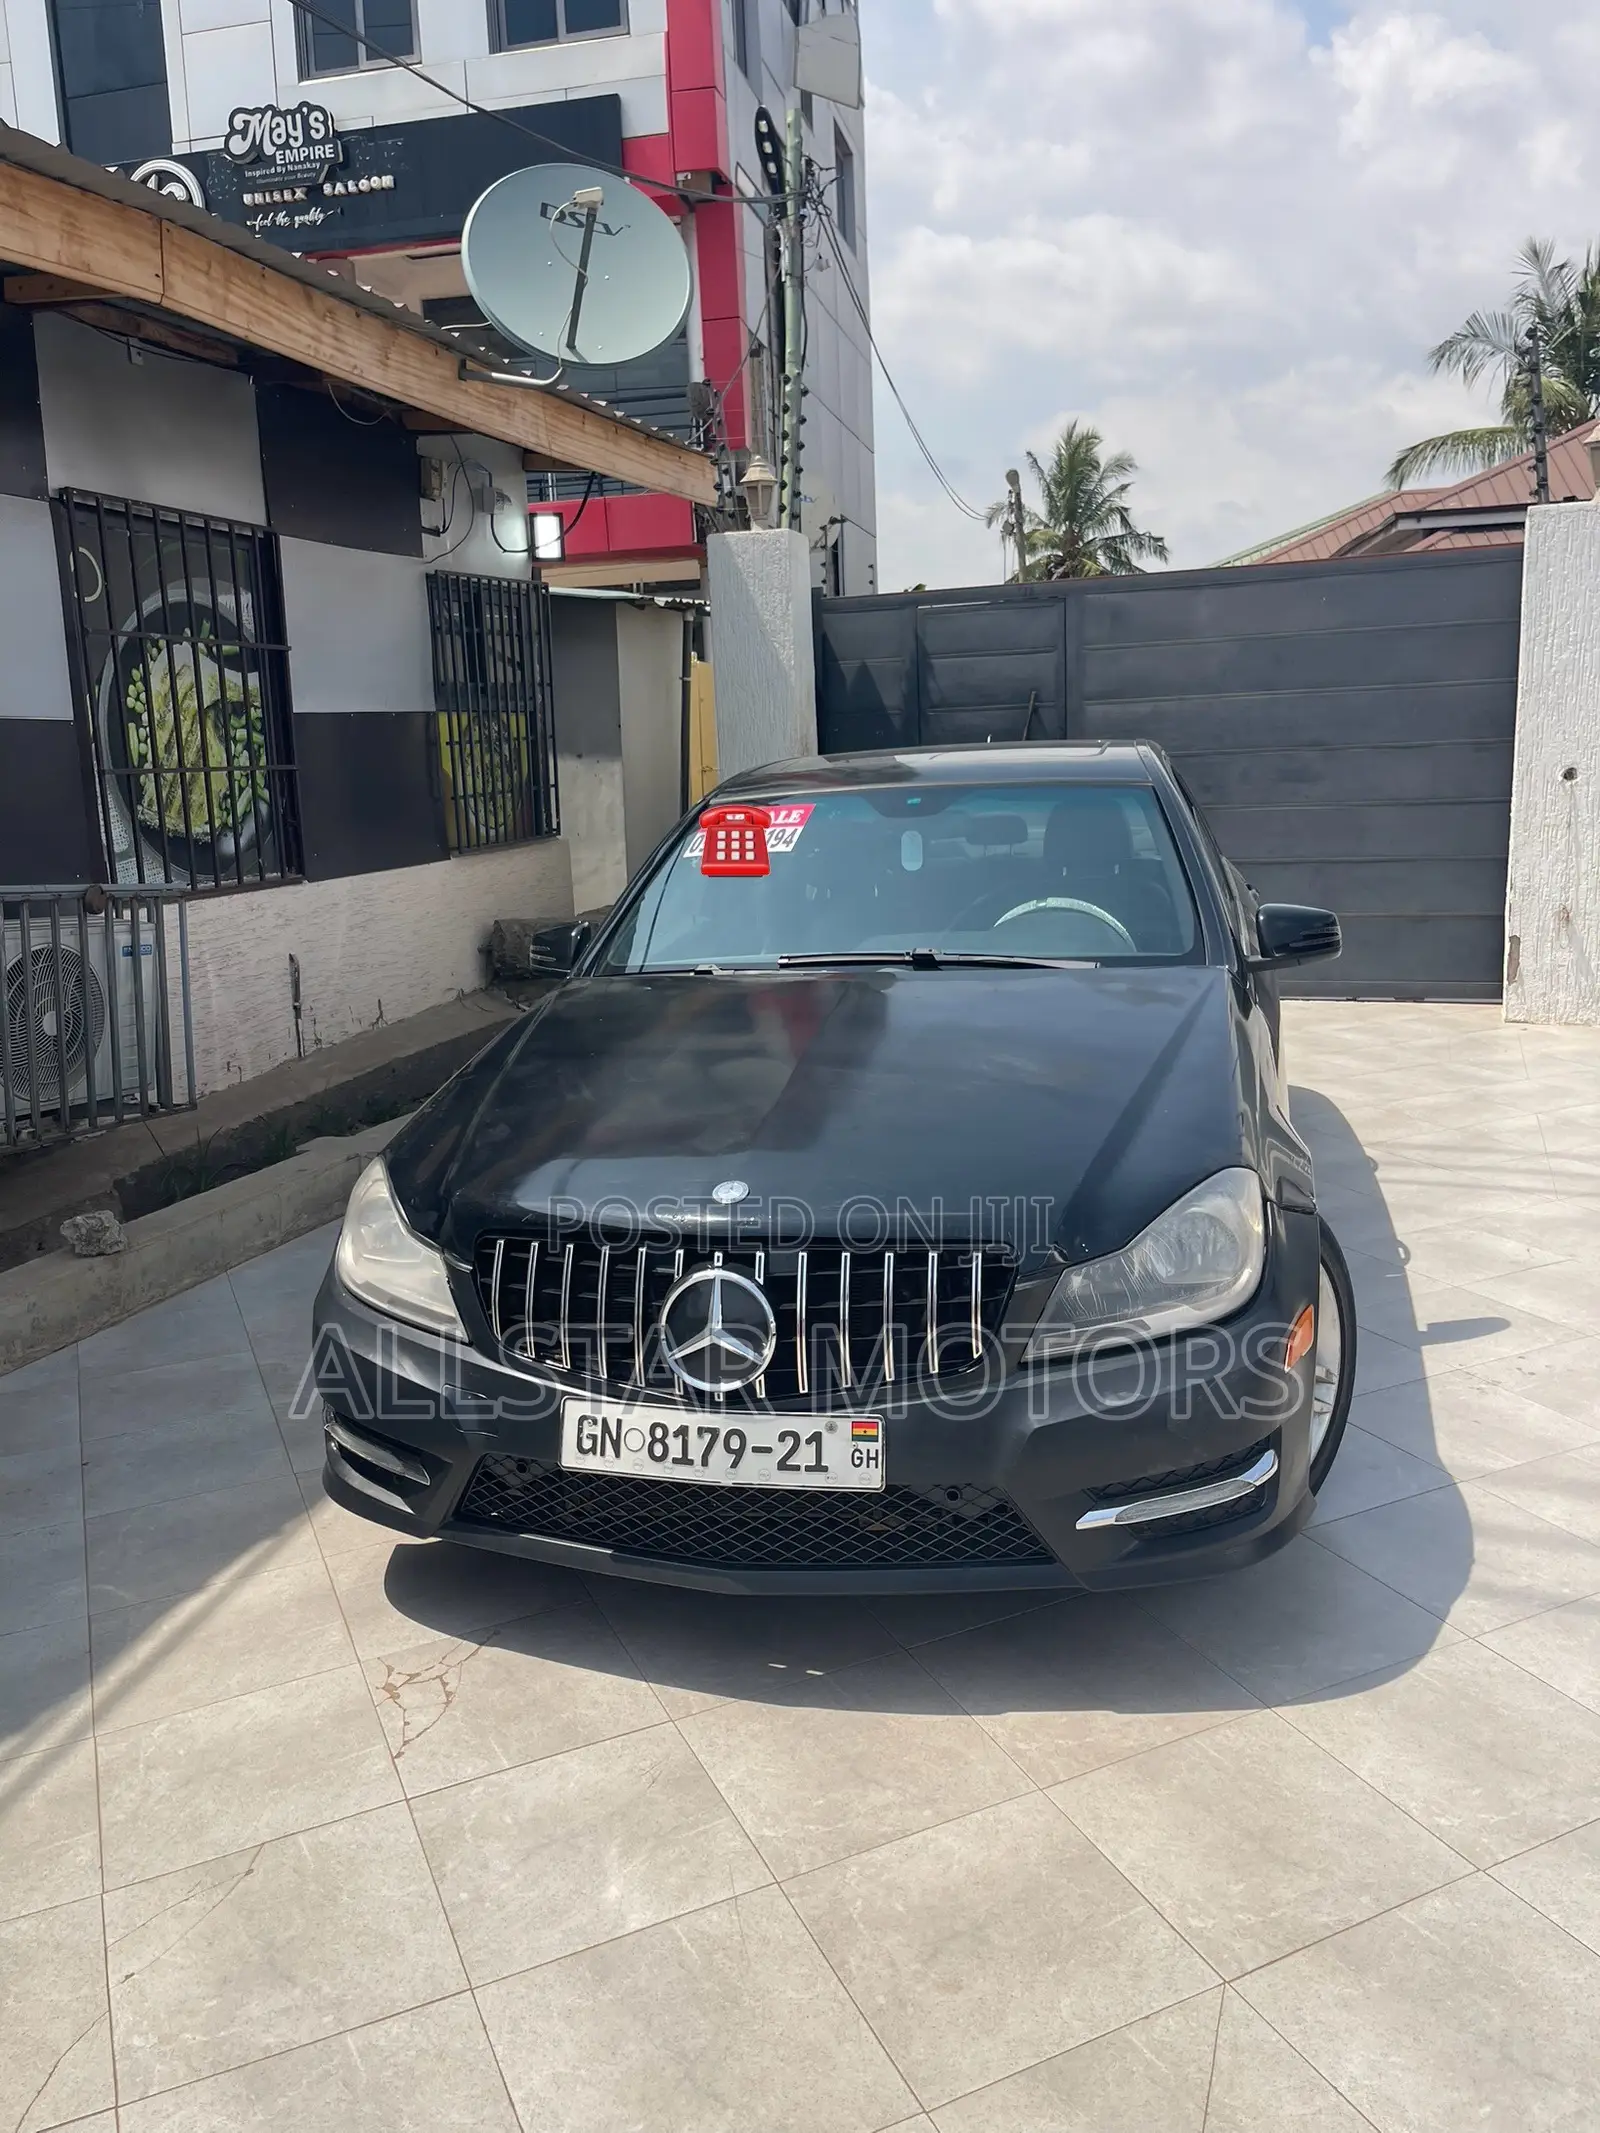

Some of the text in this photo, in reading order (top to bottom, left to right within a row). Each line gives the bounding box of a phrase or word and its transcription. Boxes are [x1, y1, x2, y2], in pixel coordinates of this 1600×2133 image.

[229, 107, 325, 155] May's
[276, 144, 334, 164] EMPIRE
[245, 166, 275, 178] Inspired
[276, 165, 286, 174] By
[243, 186, 307, 206] UNISEX
[576, 1413, 830, 1473] GN 8179-21
[850, 1448, 879, 1470] GH
